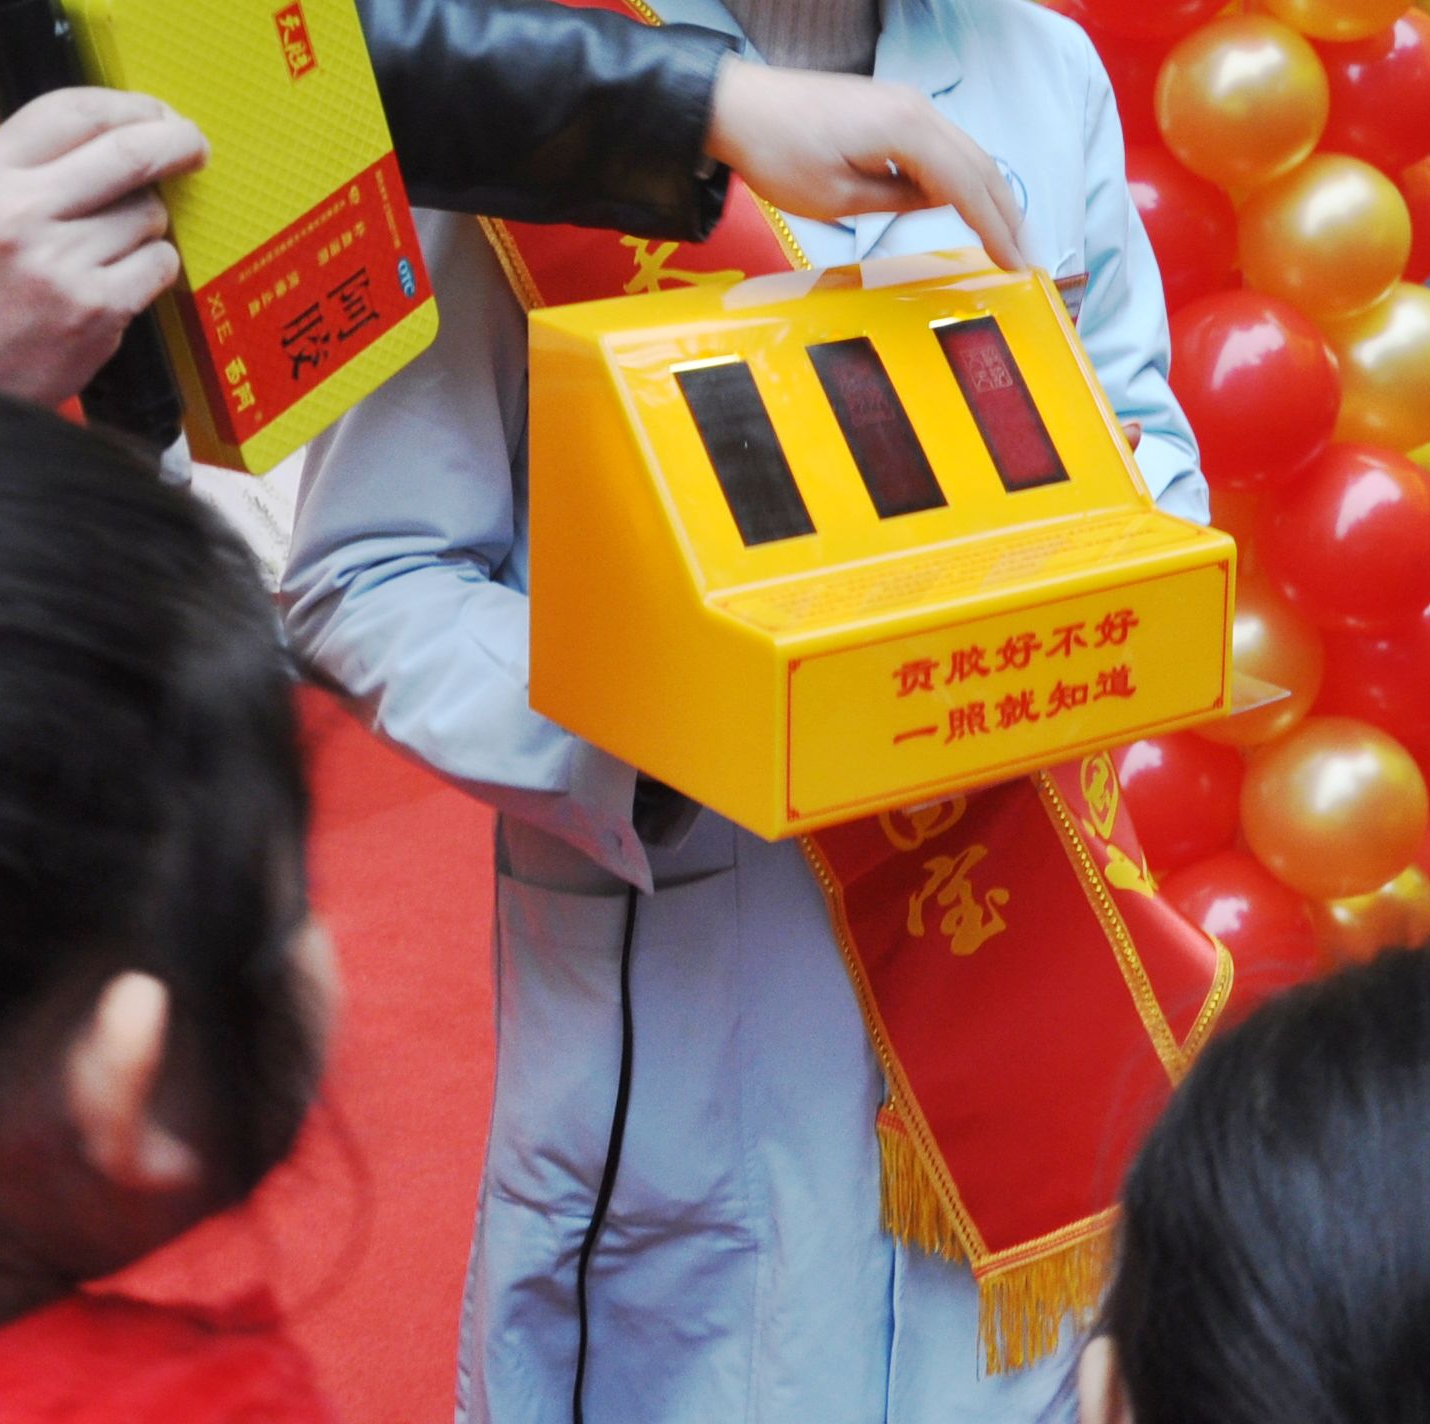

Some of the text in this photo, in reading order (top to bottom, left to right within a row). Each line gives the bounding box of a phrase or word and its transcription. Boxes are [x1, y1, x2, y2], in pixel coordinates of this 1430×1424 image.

[397, 259, 415, 297] OTC
[280, 267, 381, 380] 阿胶
[892, 607, 1139, 699] 贡胶好不好
[893, 663, 1137, 746] 一照就知道
